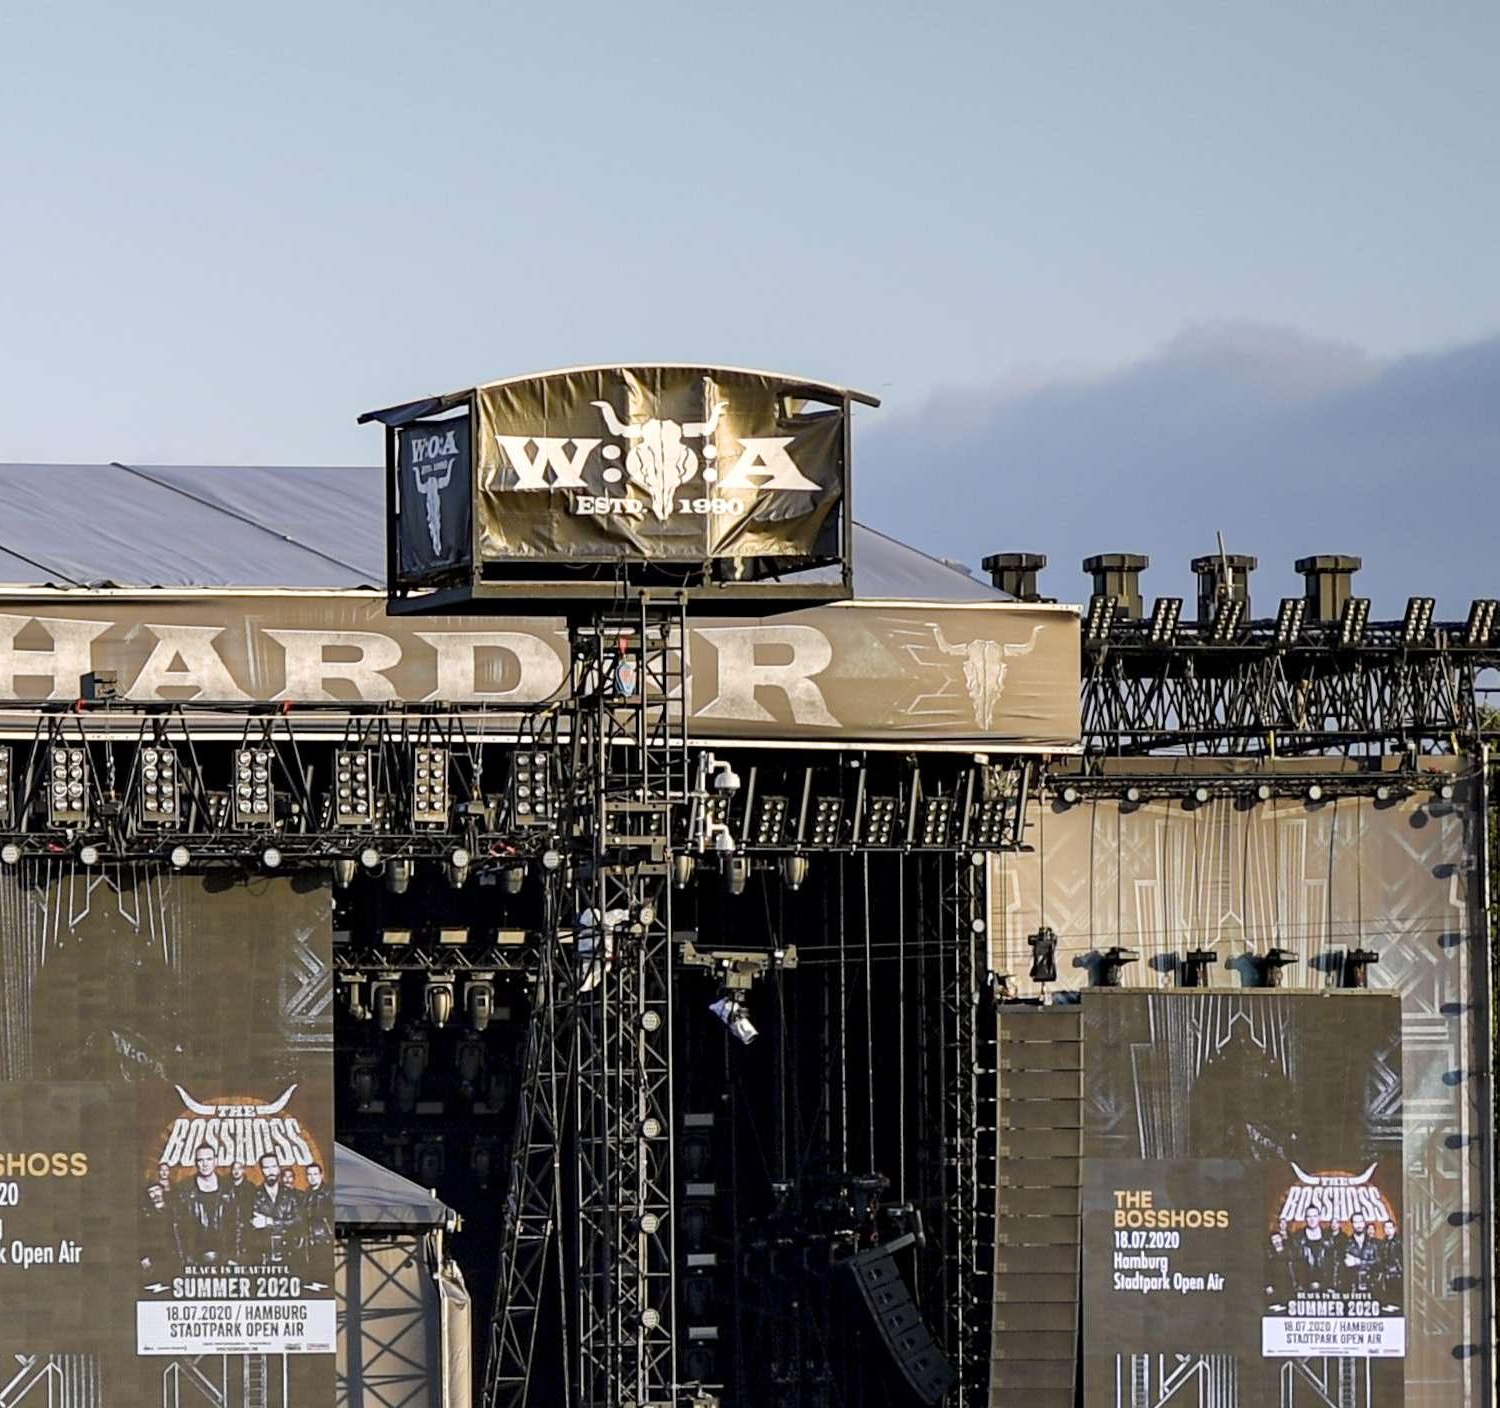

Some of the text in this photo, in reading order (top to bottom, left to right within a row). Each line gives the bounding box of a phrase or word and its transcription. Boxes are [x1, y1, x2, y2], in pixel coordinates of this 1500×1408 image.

[576, 496, 744, 515] ESTD. 1990
[159, 1118, 313, 1166] BOSSHOSS
[1114, 1191, 1152, 1208] THE
[1115, 1210, 1229, 1228] BOSSHOSS
[1115, 1231, 1180, 1248] 18.07.2020
[12, 1240, 53, 1269] Open
[58, 1240, 82, 1263] Air
[1114, 1251, 1168, 1273] Hamburg
[173, 1278, 301, 1298] SUMMER 2020
[1114, 1271, 1224, 1294] Stadtpark Open Air
[166, 1306, 232, 1320] 18.07.2020
[245, 1306, 307, 1319] HAMBURG
[1288, 1301, 1379, 1316] SUMMER 2020
[170, 1323, 304, 1337] STADTPARK OPEN AIR
[1284, 1322, 1384, 1332] 18.07.2020 HAMBURG
[1287, 1334, 1382, 1344] STADTPARK OPEN AIR
